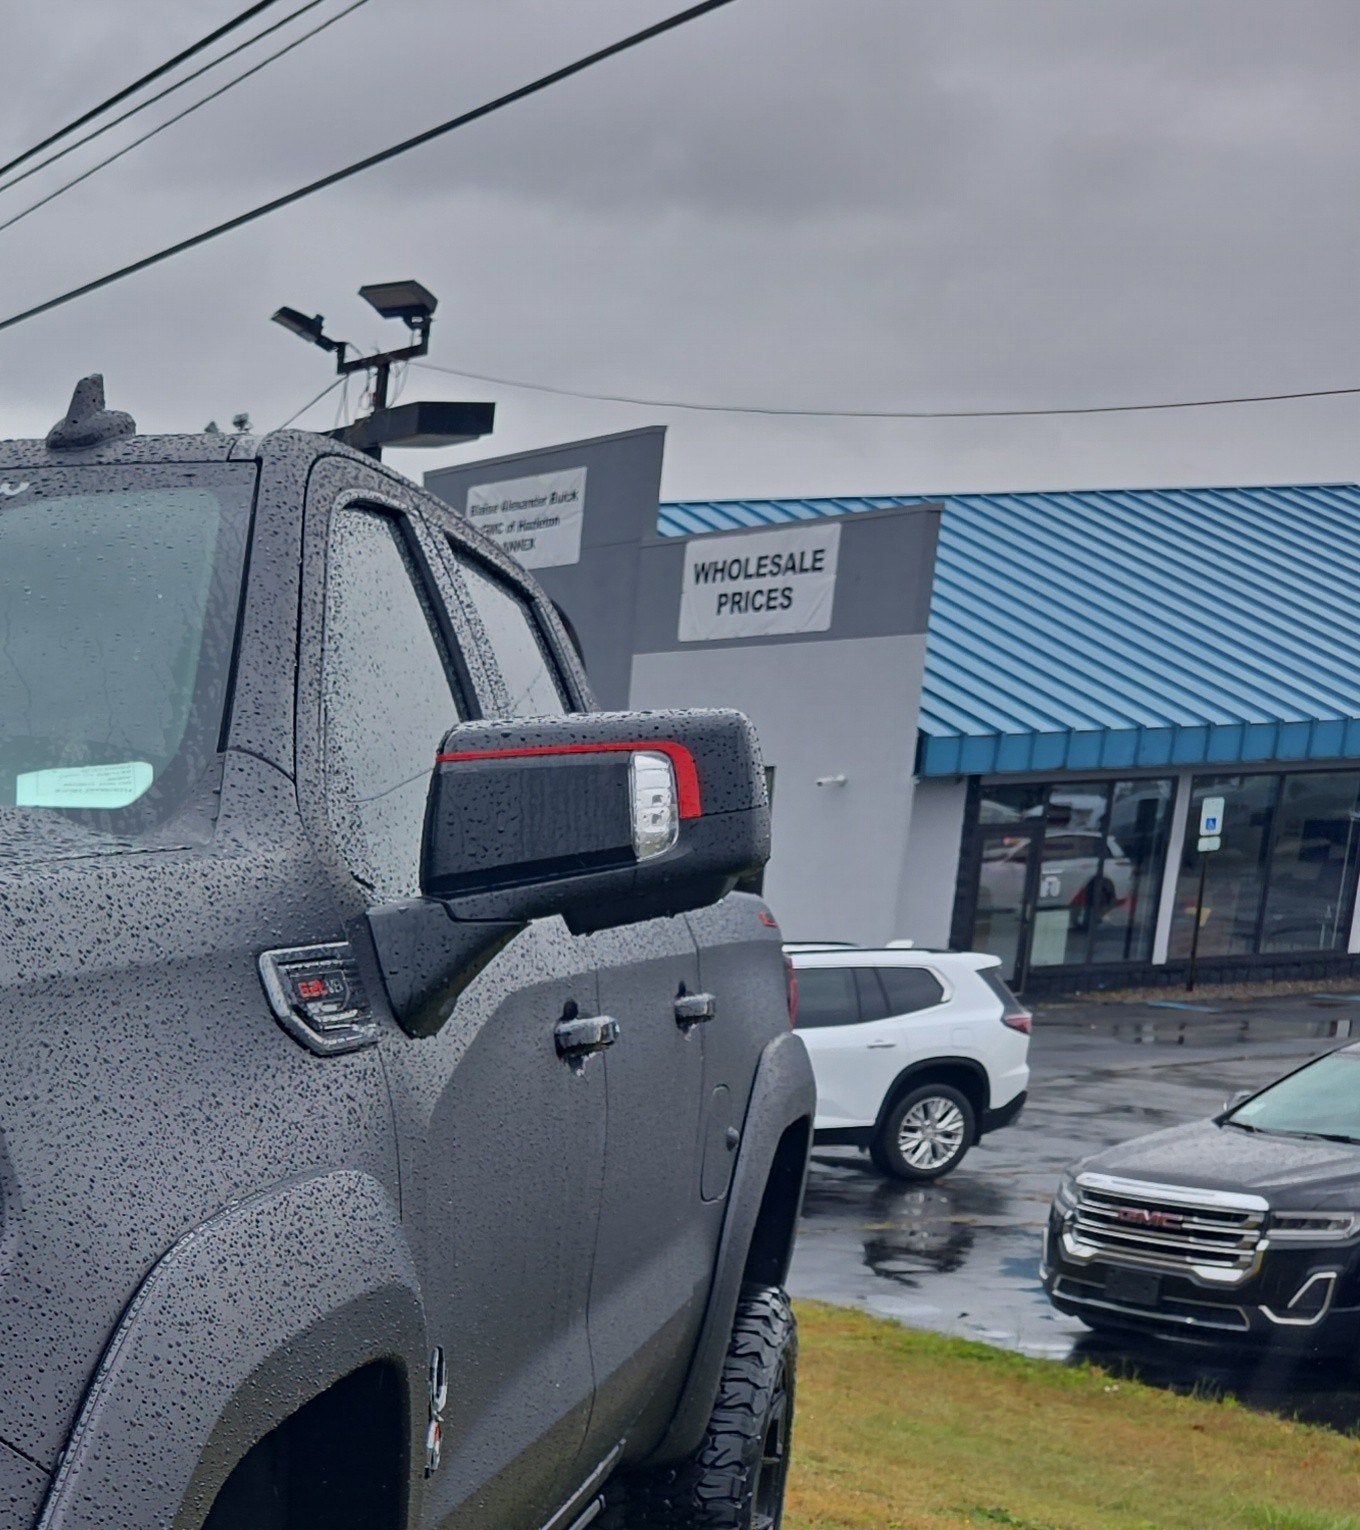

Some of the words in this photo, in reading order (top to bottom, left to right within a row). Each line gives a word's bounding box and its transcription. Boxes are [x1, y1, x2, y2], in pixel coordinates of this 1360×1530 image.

[548, 490, 579, 506] Buick
[693, 549, 827, 585] WHOLESALE
[716, 586, 794, 616] PRICES
[1118, 1205, 1184, 1229] GMC
